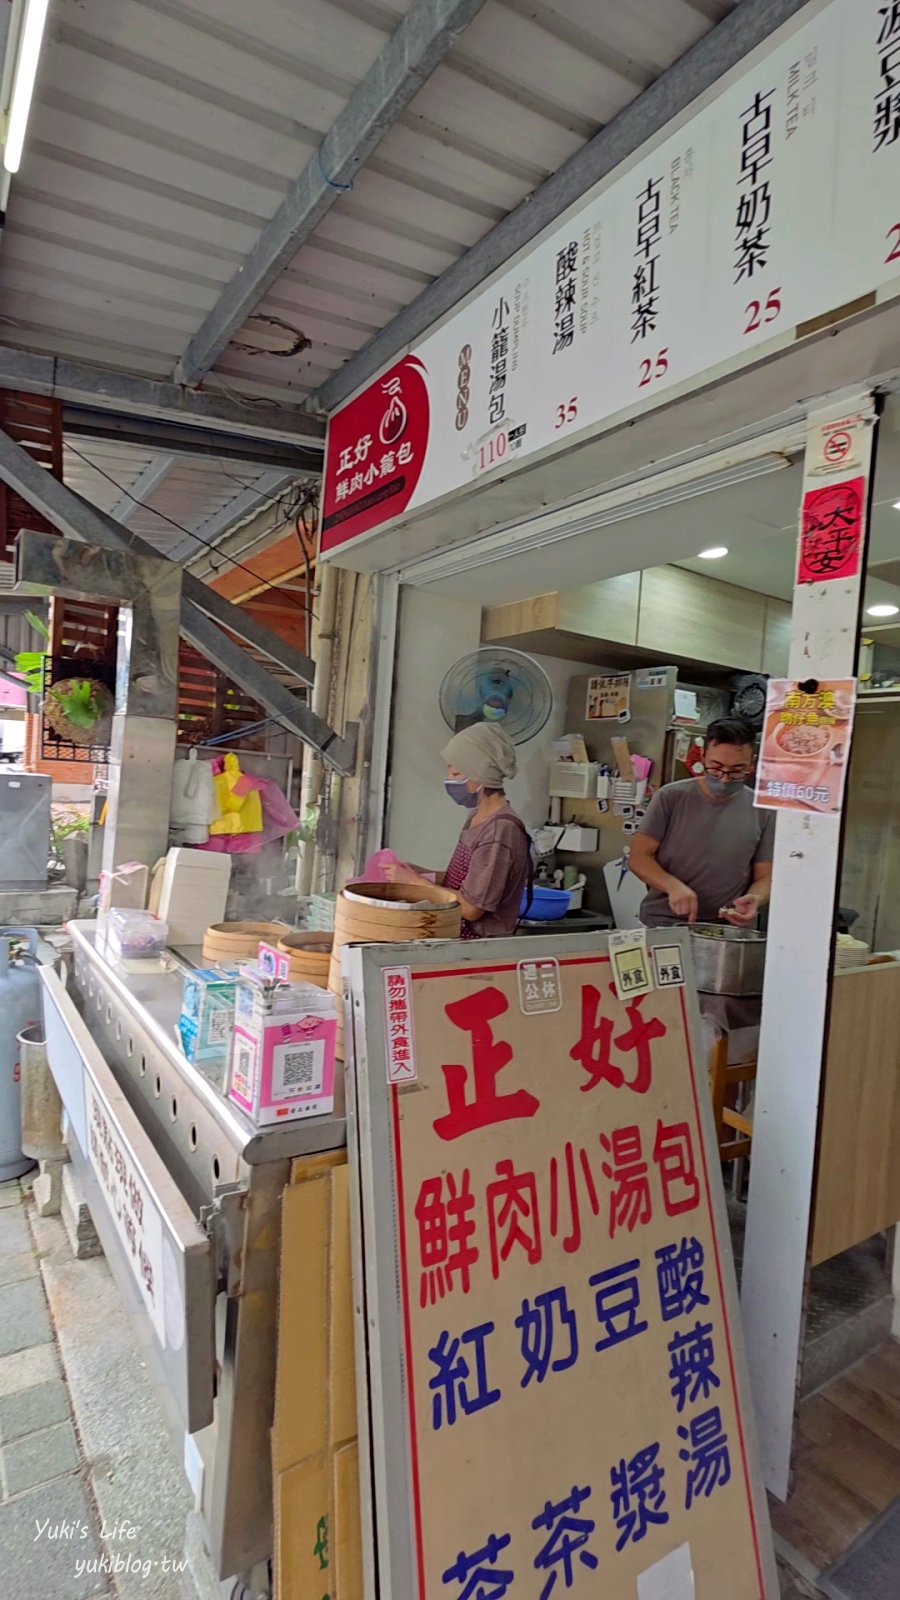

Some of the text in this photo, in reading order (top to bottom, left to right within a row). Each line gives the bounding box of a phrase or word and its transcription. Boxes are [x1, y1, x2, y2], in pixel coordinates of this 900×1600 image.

[785, 105, 799, 141] TEA
[733, 88, 776, 285] 古早奶茶
[630, 176, 664, 344] 古早紅茶
[552, 241, 578, 355] 酸辣湯
[743, 287, 782, 335] 25
[455, 343, 472, 431] MENU
[487, 297, 510, 424] 小籠湯包
[638, 348, 669, 388] 25
[555, 397, 578, 429] 35
[335, 442, 414, 502] 鮮肉小籠包
[336, 434, 373, 476] 正好
[480, 432, 506, 470] 110
[766, 780, 830, 803] 特價60元
[525, 981, 556, 1000] 公休
[622, 969, 644, 987] 外食
[660, 966, 681, 981] 外食
[387, 974, 412, 1076] 請勿攜帶外食進入
[433, 984, 667, 1142] 正好
[413, 1119, 701, 1309] 鮮肉小湯包
[654, 1235, 731, 1510] 酸辣湯
